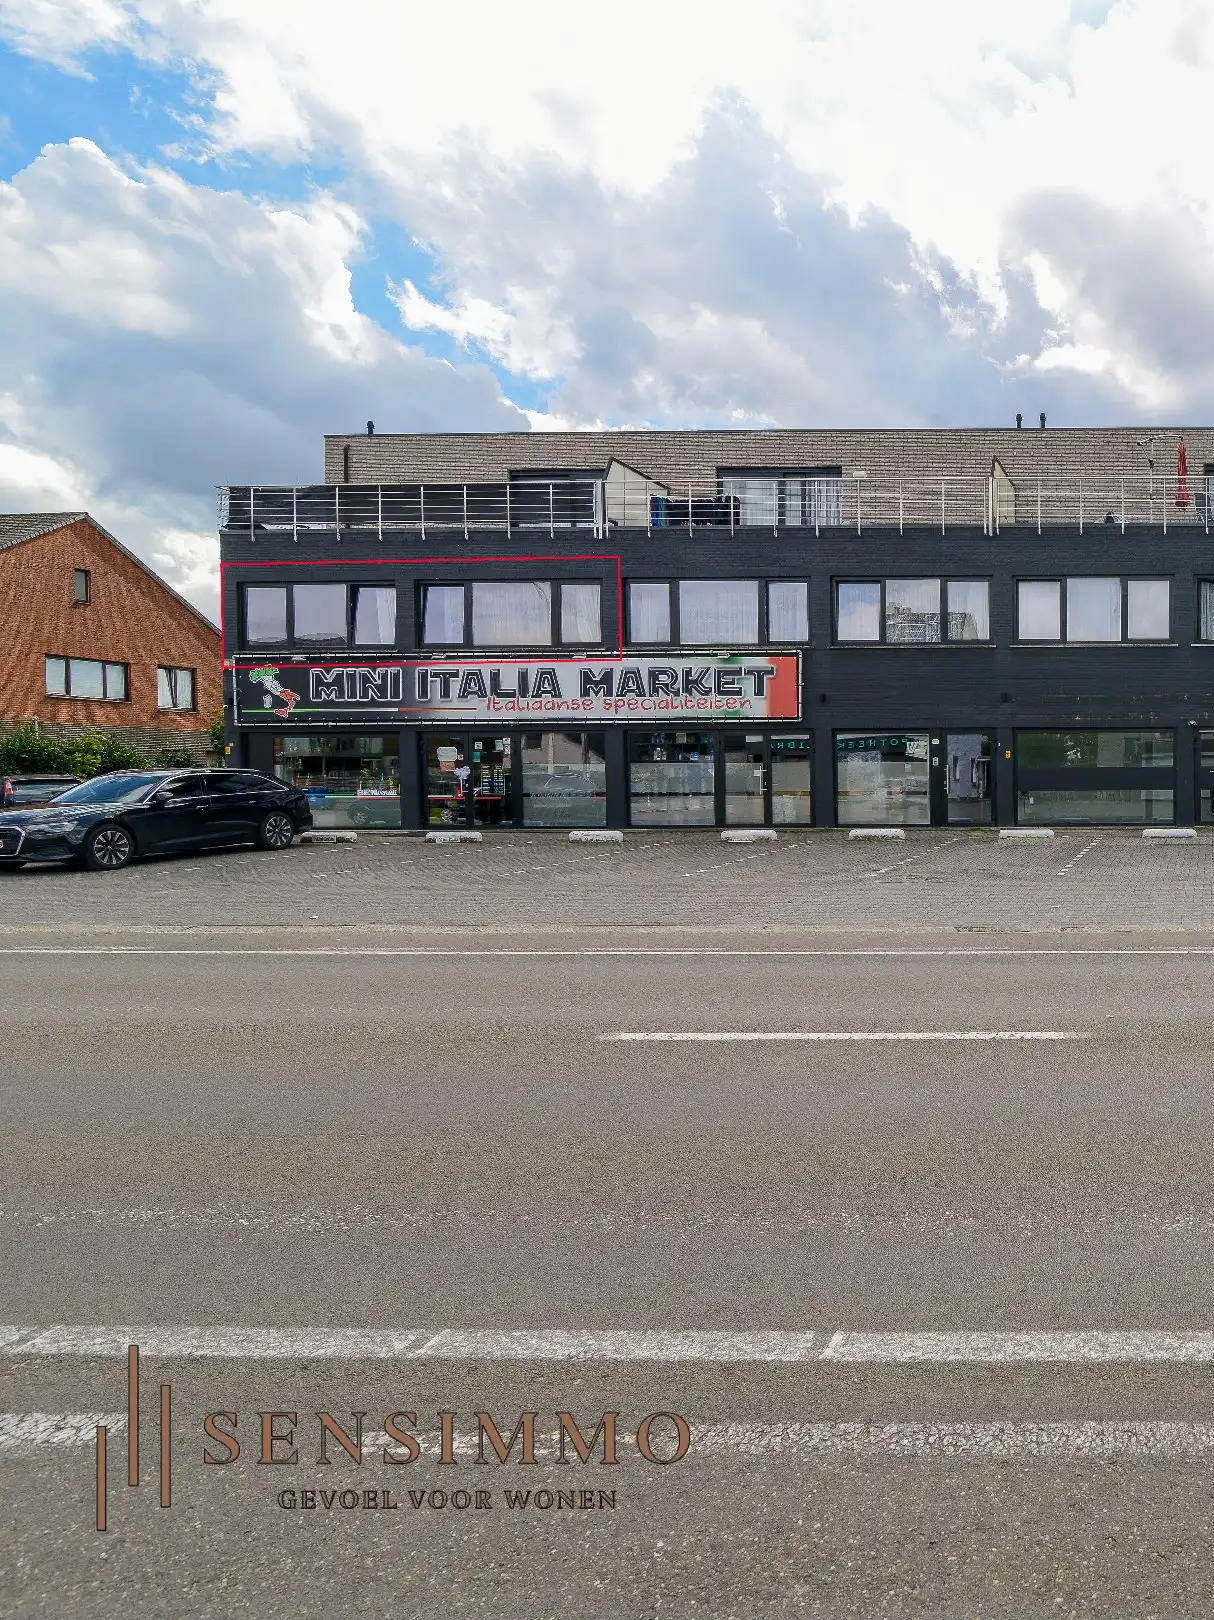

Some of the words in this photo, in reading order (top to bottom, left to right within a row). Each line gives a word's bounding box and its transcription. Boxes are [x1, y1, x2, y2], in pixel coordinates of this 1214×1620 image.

[310, 667, 402, 701] MINI
[415, 667, 563, 700] ITALIA
[578, 665, 777, 698] MARKET
[486, 693, 595, 712] Italiaanse
[602, 692, 753, 714] specialiteiten
